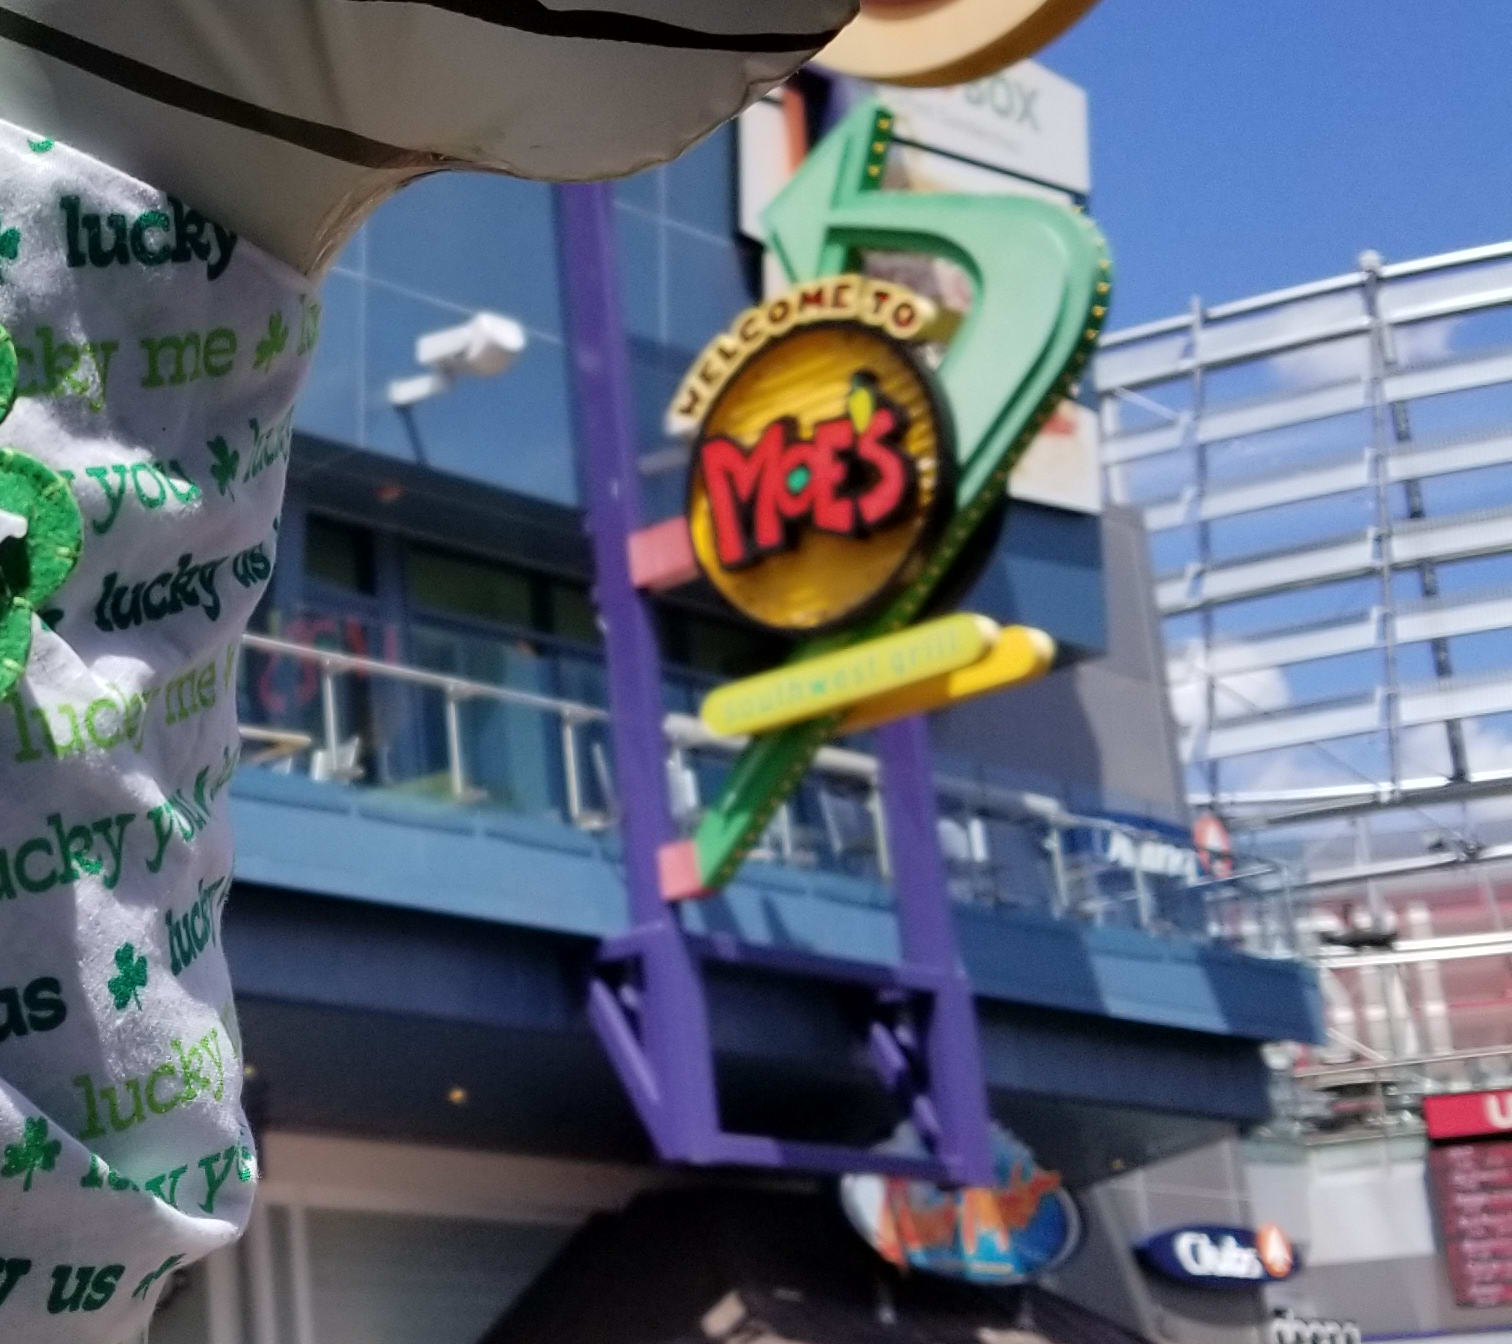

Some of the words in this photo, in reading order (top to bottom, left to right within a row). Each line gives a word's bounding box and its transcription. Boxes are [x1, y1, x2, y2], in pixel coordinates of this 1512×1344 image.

[59, 194, 238, 282] lucky
[141, 326, 237, 388] me
[677, 285, 851, 417] WELCOME
[873, 290, 916, 329] TO
[86, 458, 202, 535] you
[94, 552, 230, 634] lucky
[163, 660, 217, 725] me
[72, 1027, 226, 1141] lucky
[46, 1264, 126, 1315] us
